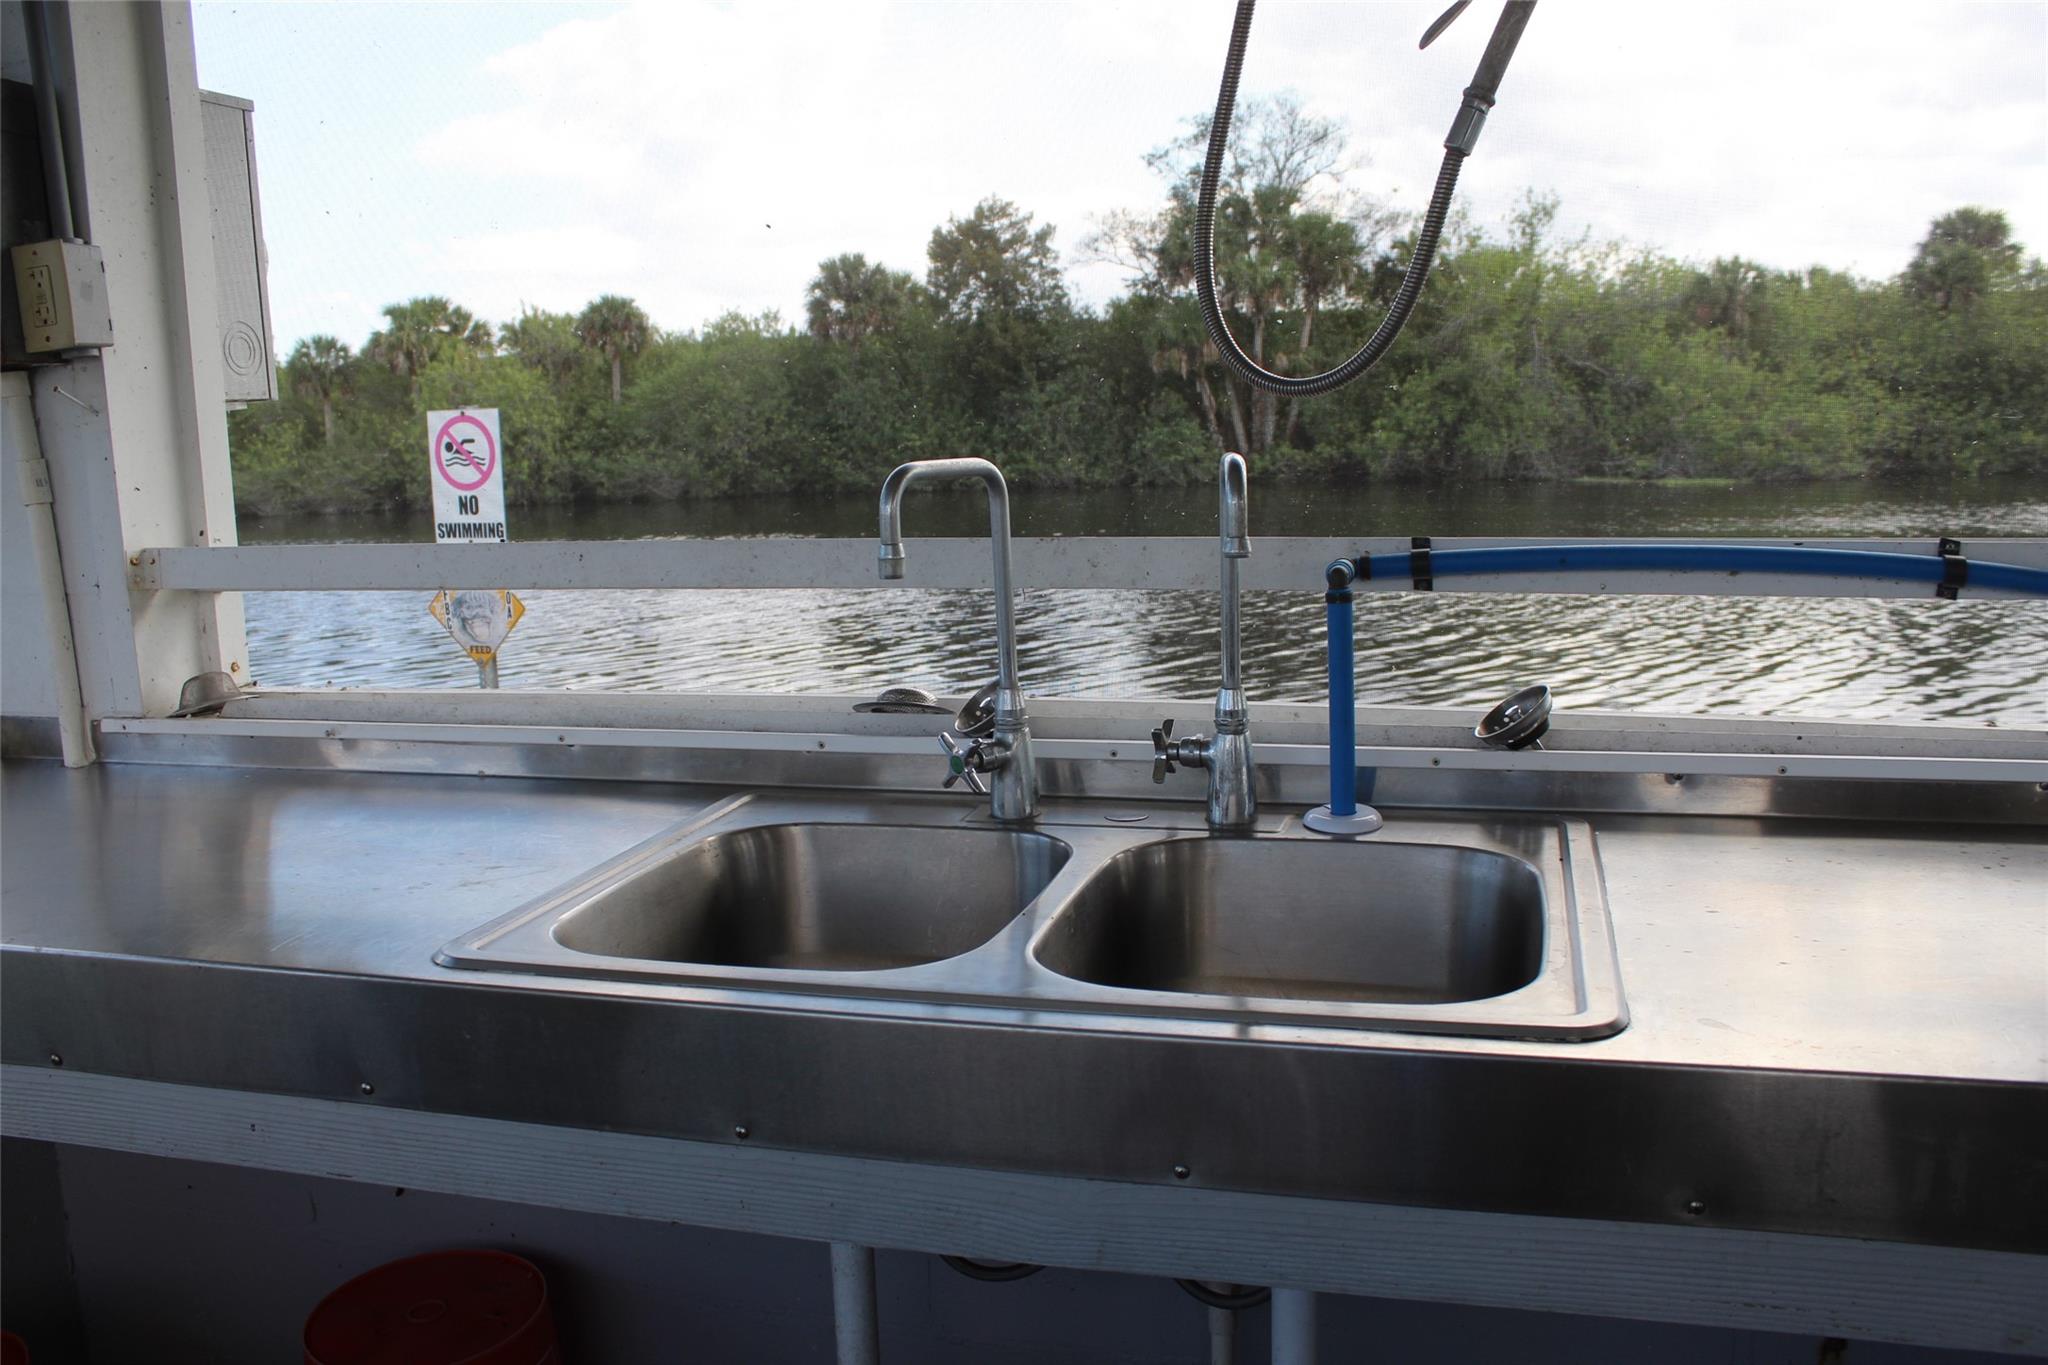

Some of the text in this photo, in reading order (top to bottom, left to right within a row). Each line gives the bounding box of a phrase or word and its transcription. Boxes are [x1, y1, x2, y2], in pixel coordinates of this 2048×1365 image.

[458, 495, 480, 515] NO
[437, 522, 504, 539] SWIMMING
[469, 645, 492, 654] FEED
